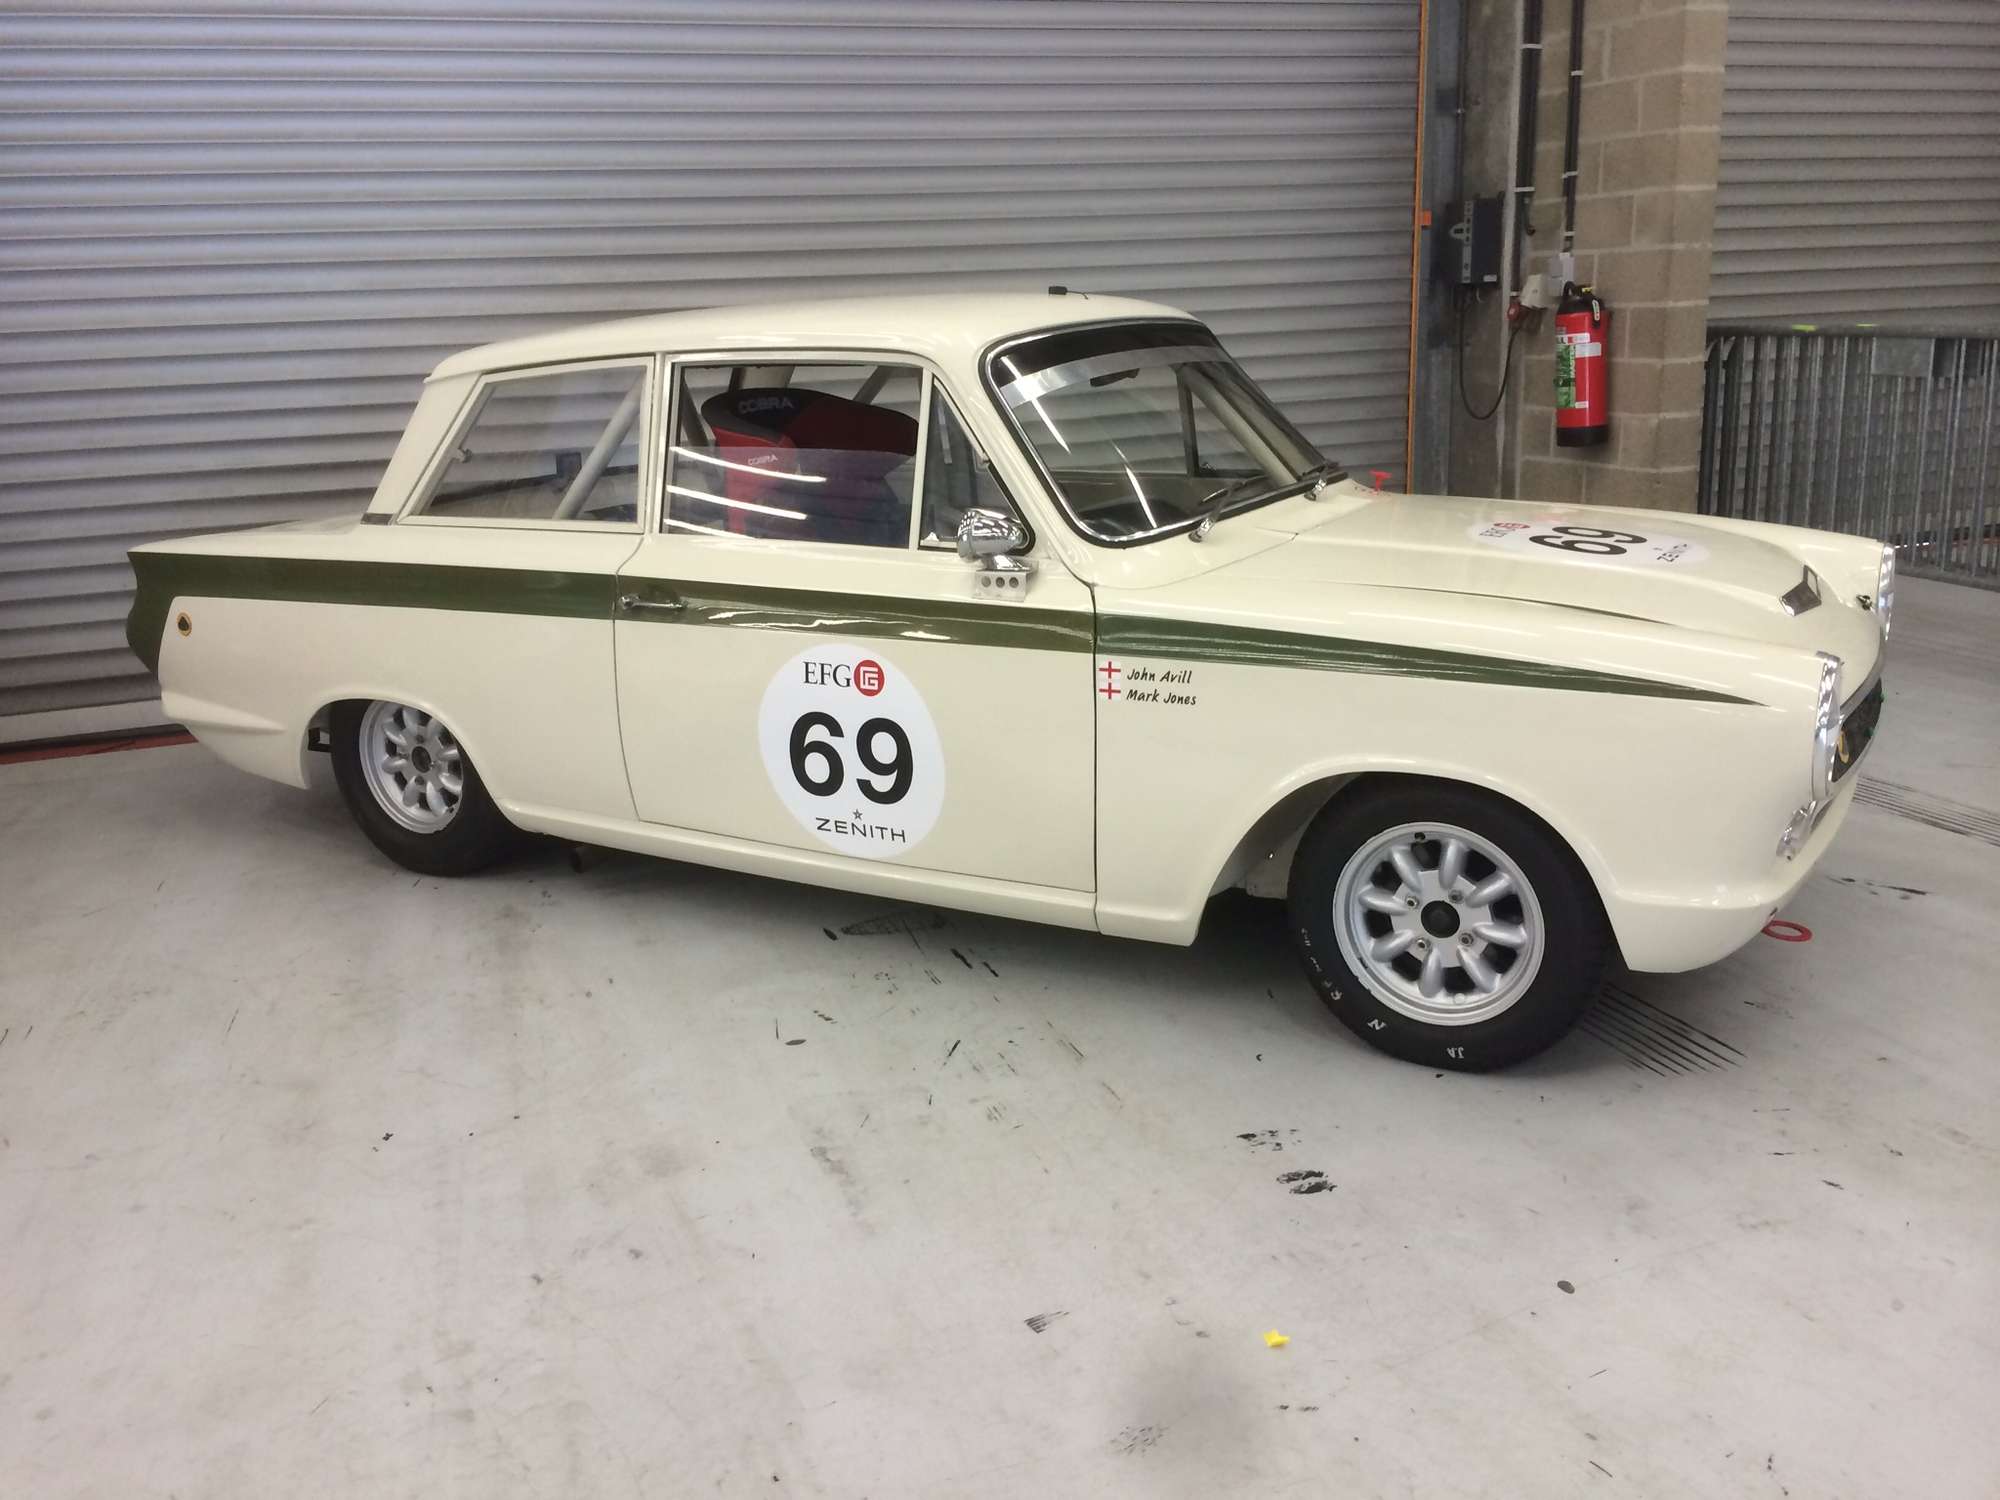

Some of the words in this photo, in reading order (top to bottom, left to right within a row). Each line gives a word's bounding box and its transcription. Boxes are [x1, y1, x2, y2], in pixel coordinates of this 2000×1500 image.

[738, 397, 794, 414] COBRA
[747, 454, 779, 466] COBRA
[1529, 526, 1648, 555] 69
[803, 661, 851, 687] EFG
[1127, 667, 1156, 681] John
[1160, 670, 1192, 684] Avill
[1126, 688, 1160, 703] Mark
[1163, 692, 1197, 706] Jones
[789, 711, 914, 805] 69
[815, 817, 907, 843] ZENITH
